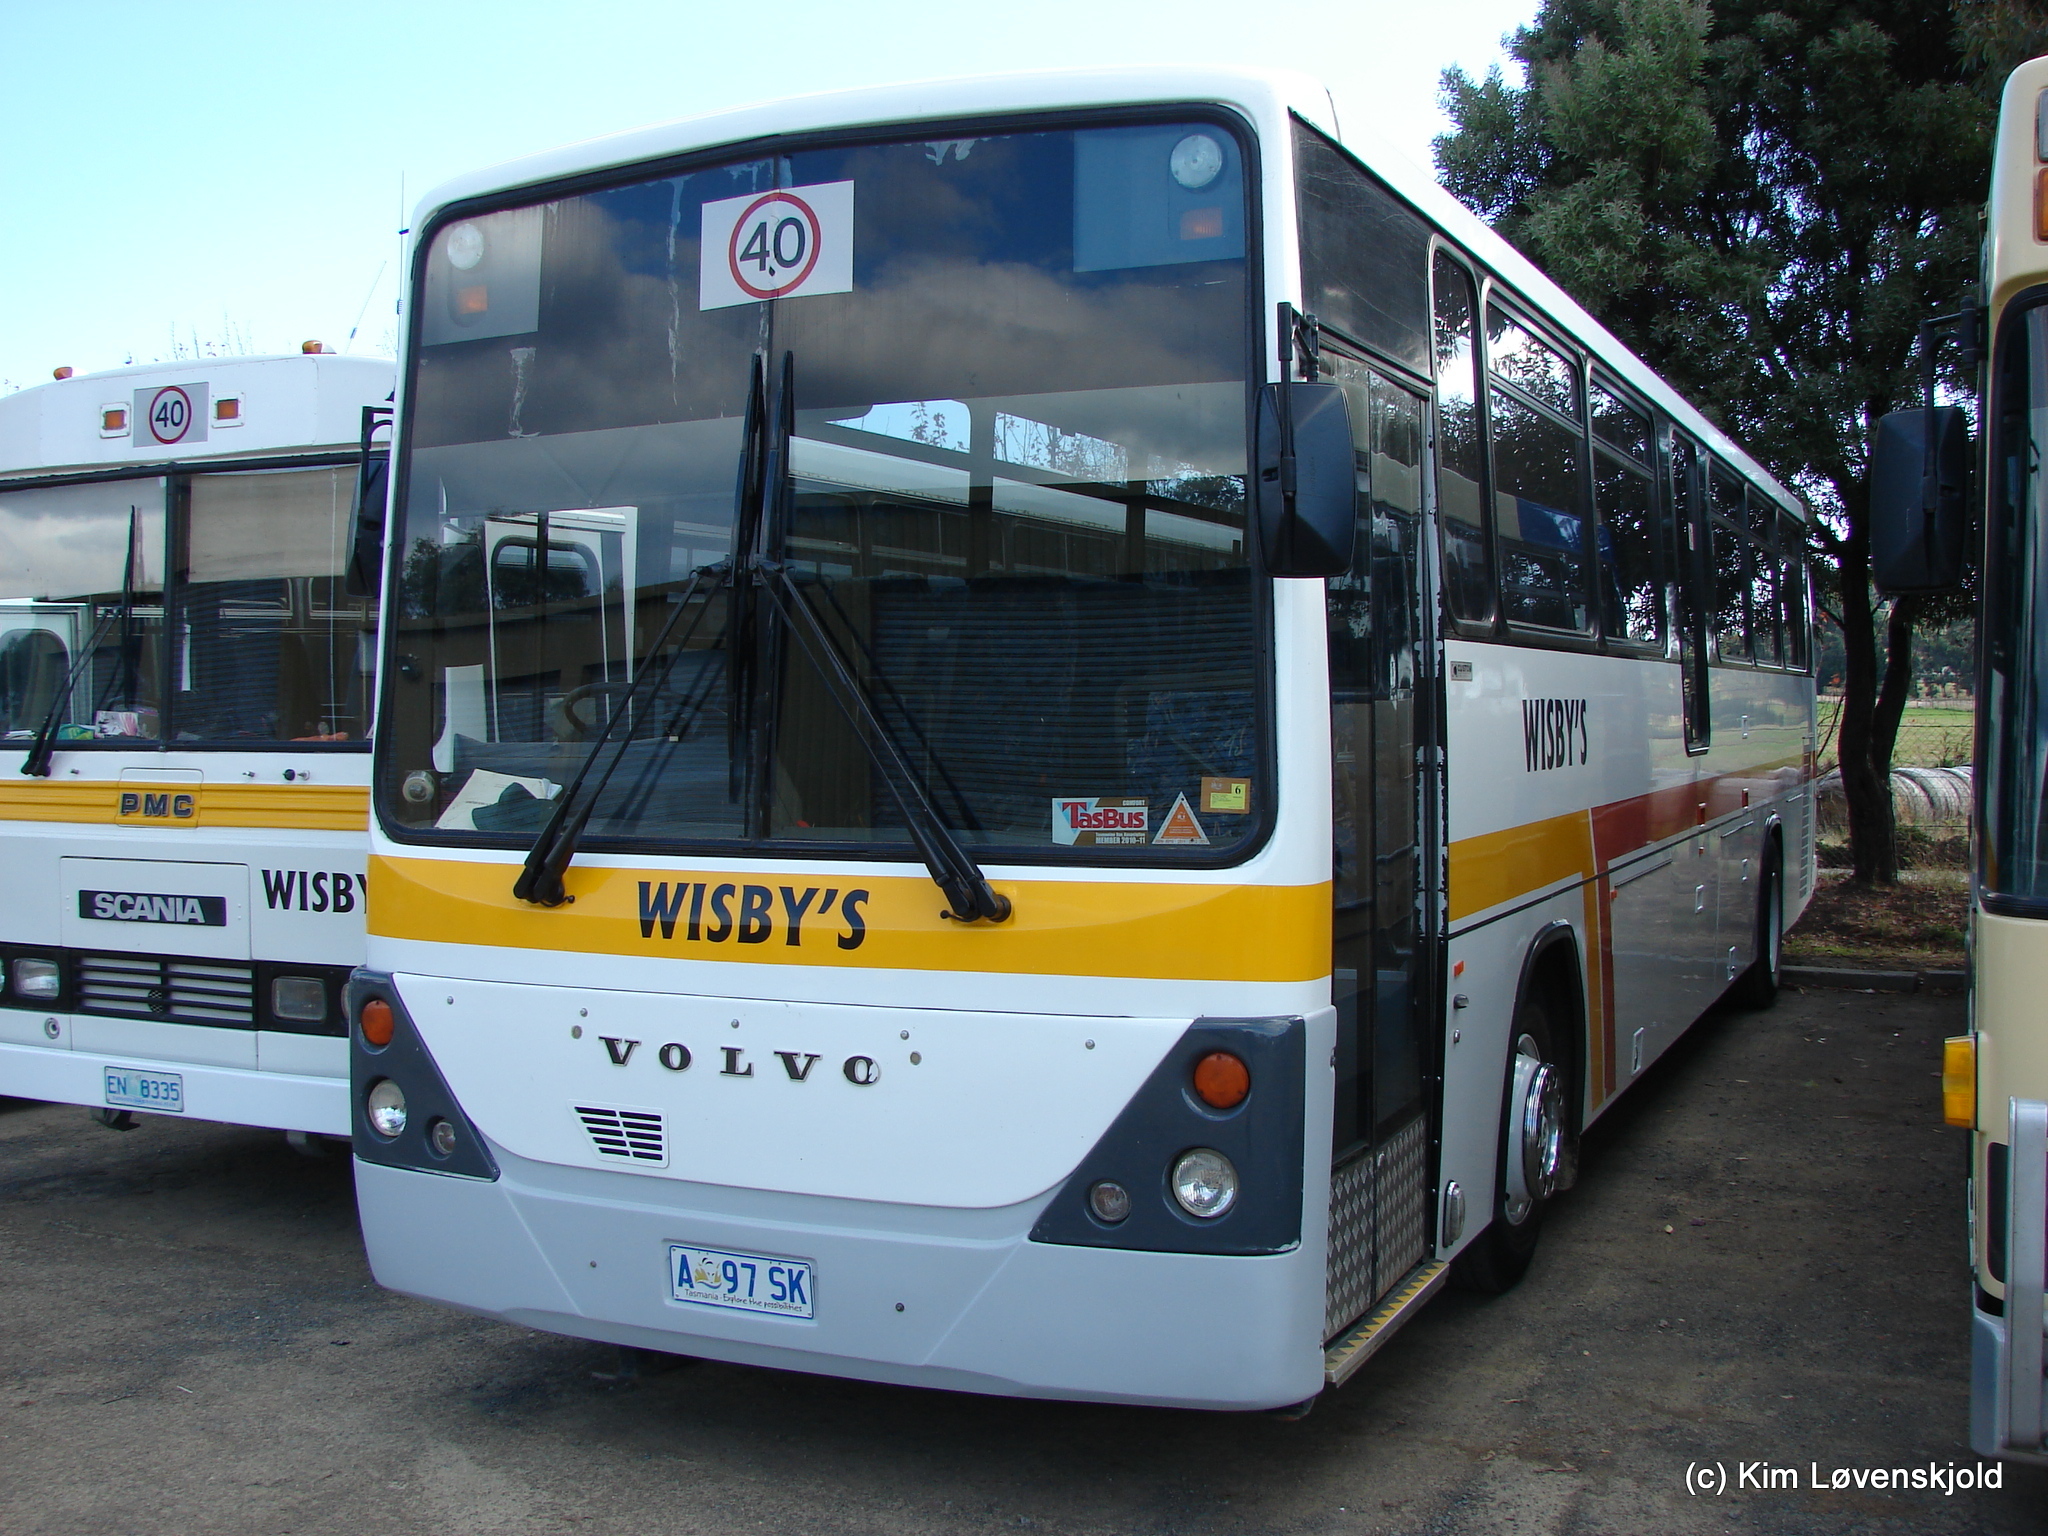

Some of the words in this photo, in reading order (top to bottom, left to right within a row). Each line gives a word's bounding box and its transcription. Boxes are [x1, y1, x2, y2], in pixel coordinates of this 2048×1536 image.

[739, 216, 806, 272] 40
[154, 399, 185, 428] 40
[1522, 698, 1588, 773] WISBY'S
[1234, 785, 1242, 795] 6
[120, 792, 196, 818] PMC
[1061, 802, 1145, 829] TasBus
[1095, 836, 1121, 844] MEMBER
[93, 892, 206, 925] SCANIA
[637, 880, 870, 951] WISBY'S
[598, 1035, 882, 1087] VOLVO
[107, 1075, 127, 1096] EN
[140, 1079, 180, 1102] 8335
[677, 1253, 695, 1289] A
[721, 1259, 757, 1298] 97
[768, 1266, 807, 1305] SK
[684, 1288, 719, 1301] Tasmania
[722, 1293, 747, 1305] Explore
[748, 1298, 762, 1307] the
[764, 1300, 803, 1312] possibilities
